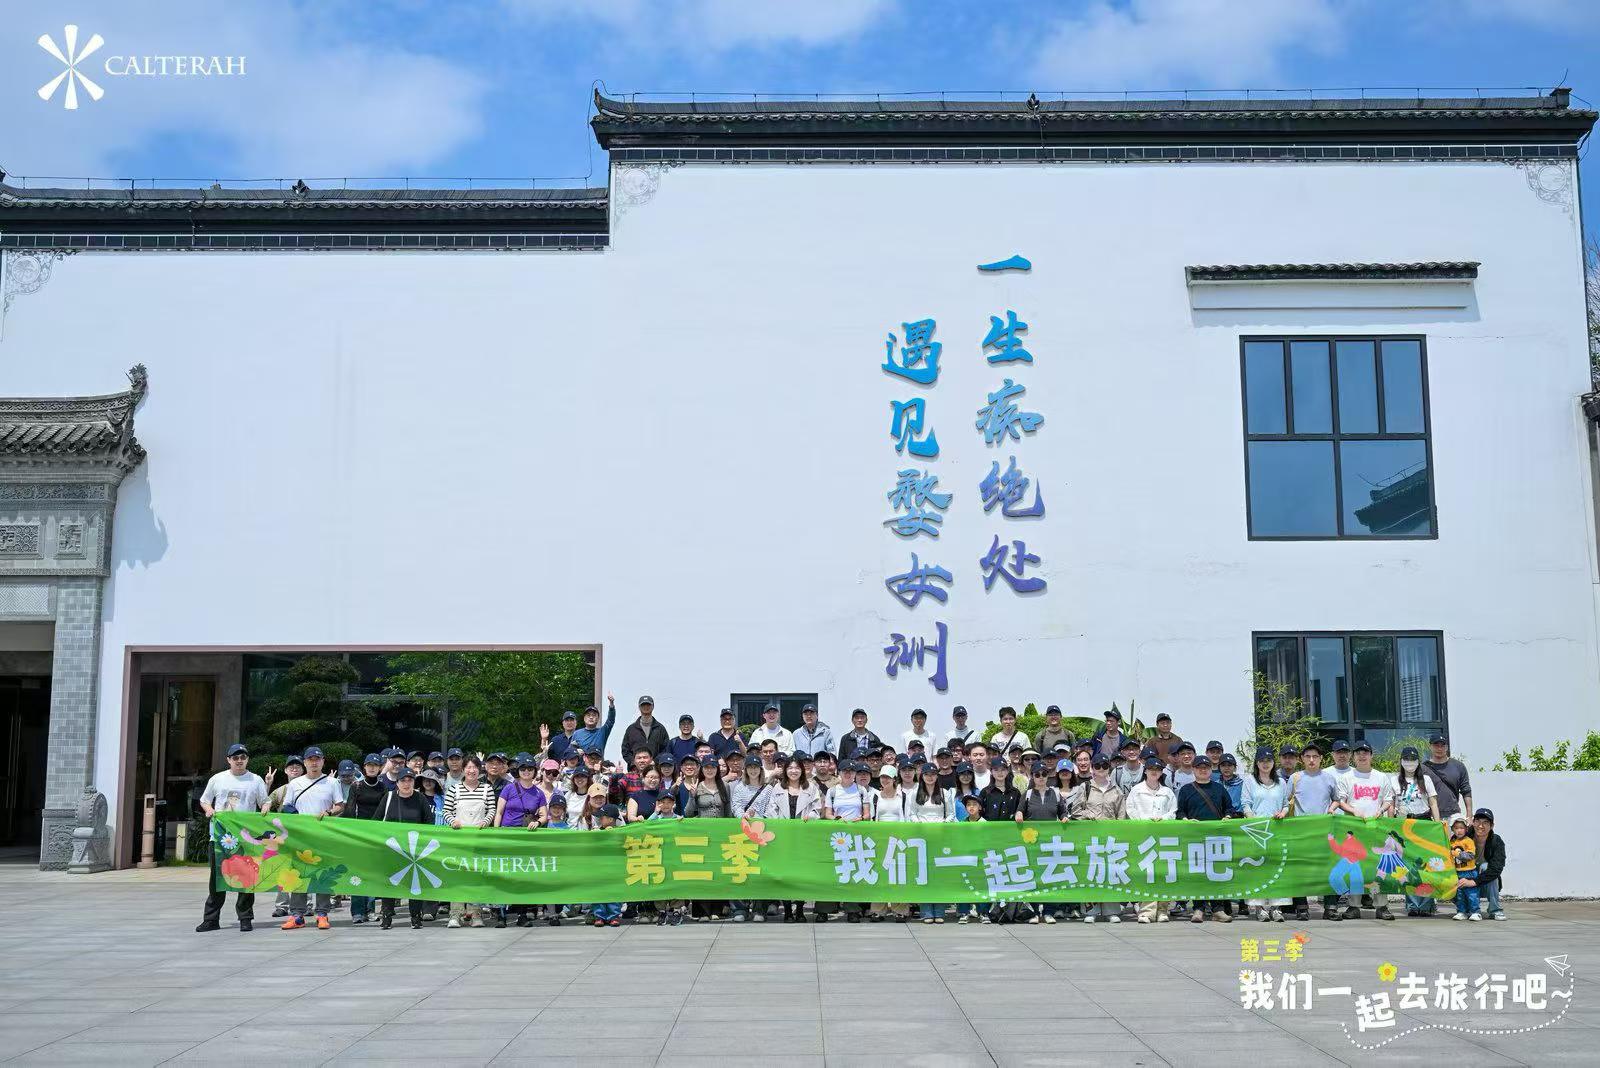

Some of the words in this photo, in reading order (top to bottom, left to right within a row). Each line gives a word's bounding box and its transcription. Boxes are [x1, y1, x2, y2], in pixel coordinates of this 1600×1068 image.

[881, 318, 953, 692] 遇见婺女洲
[976, 254, 1047, 594] 一生痴绝处
[441, 856, 558, 873] CALTERAH
[624, 833, 761, 886] 第三季
